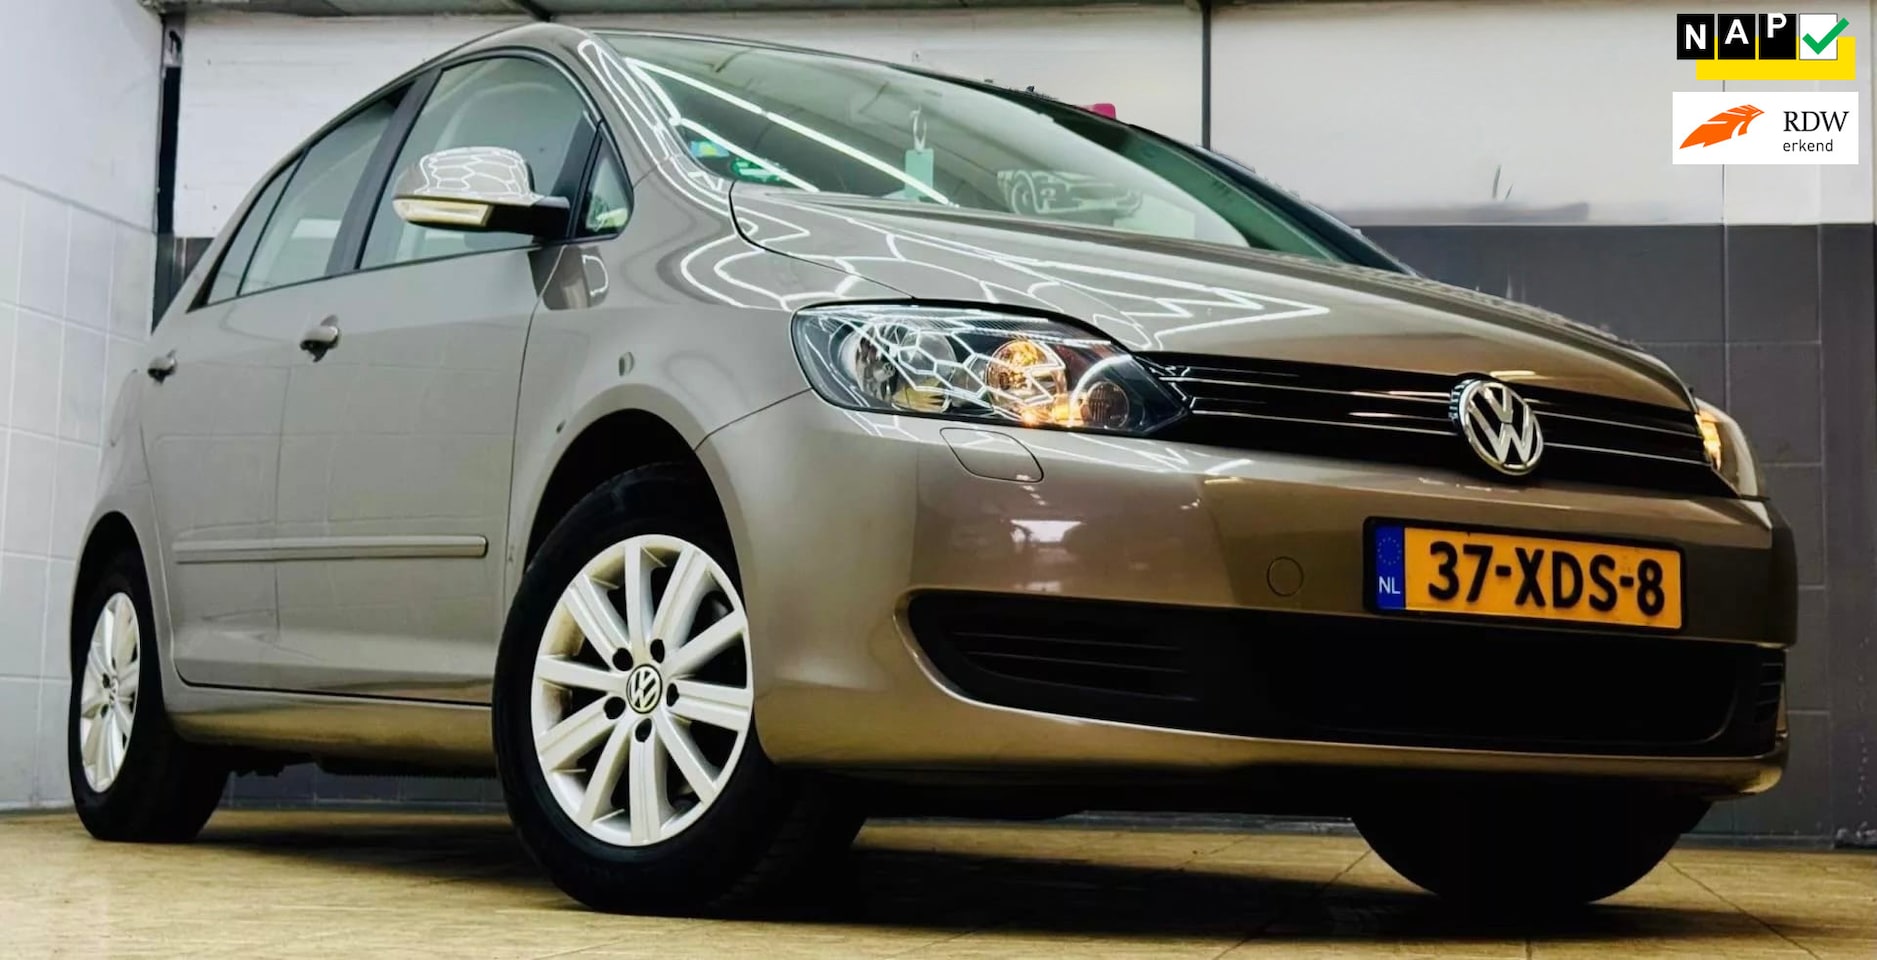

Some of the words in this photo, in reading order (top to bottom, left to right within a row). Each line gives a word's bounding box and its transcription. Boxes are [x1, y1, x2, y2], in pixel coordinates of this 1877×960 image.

[1464, 382, 1538, 467] VW
[1379, 576, 1401, 595] NL
[1428, 541, 1666, 616] 37-XDS-8
[629, 667, 660, 711] VW
